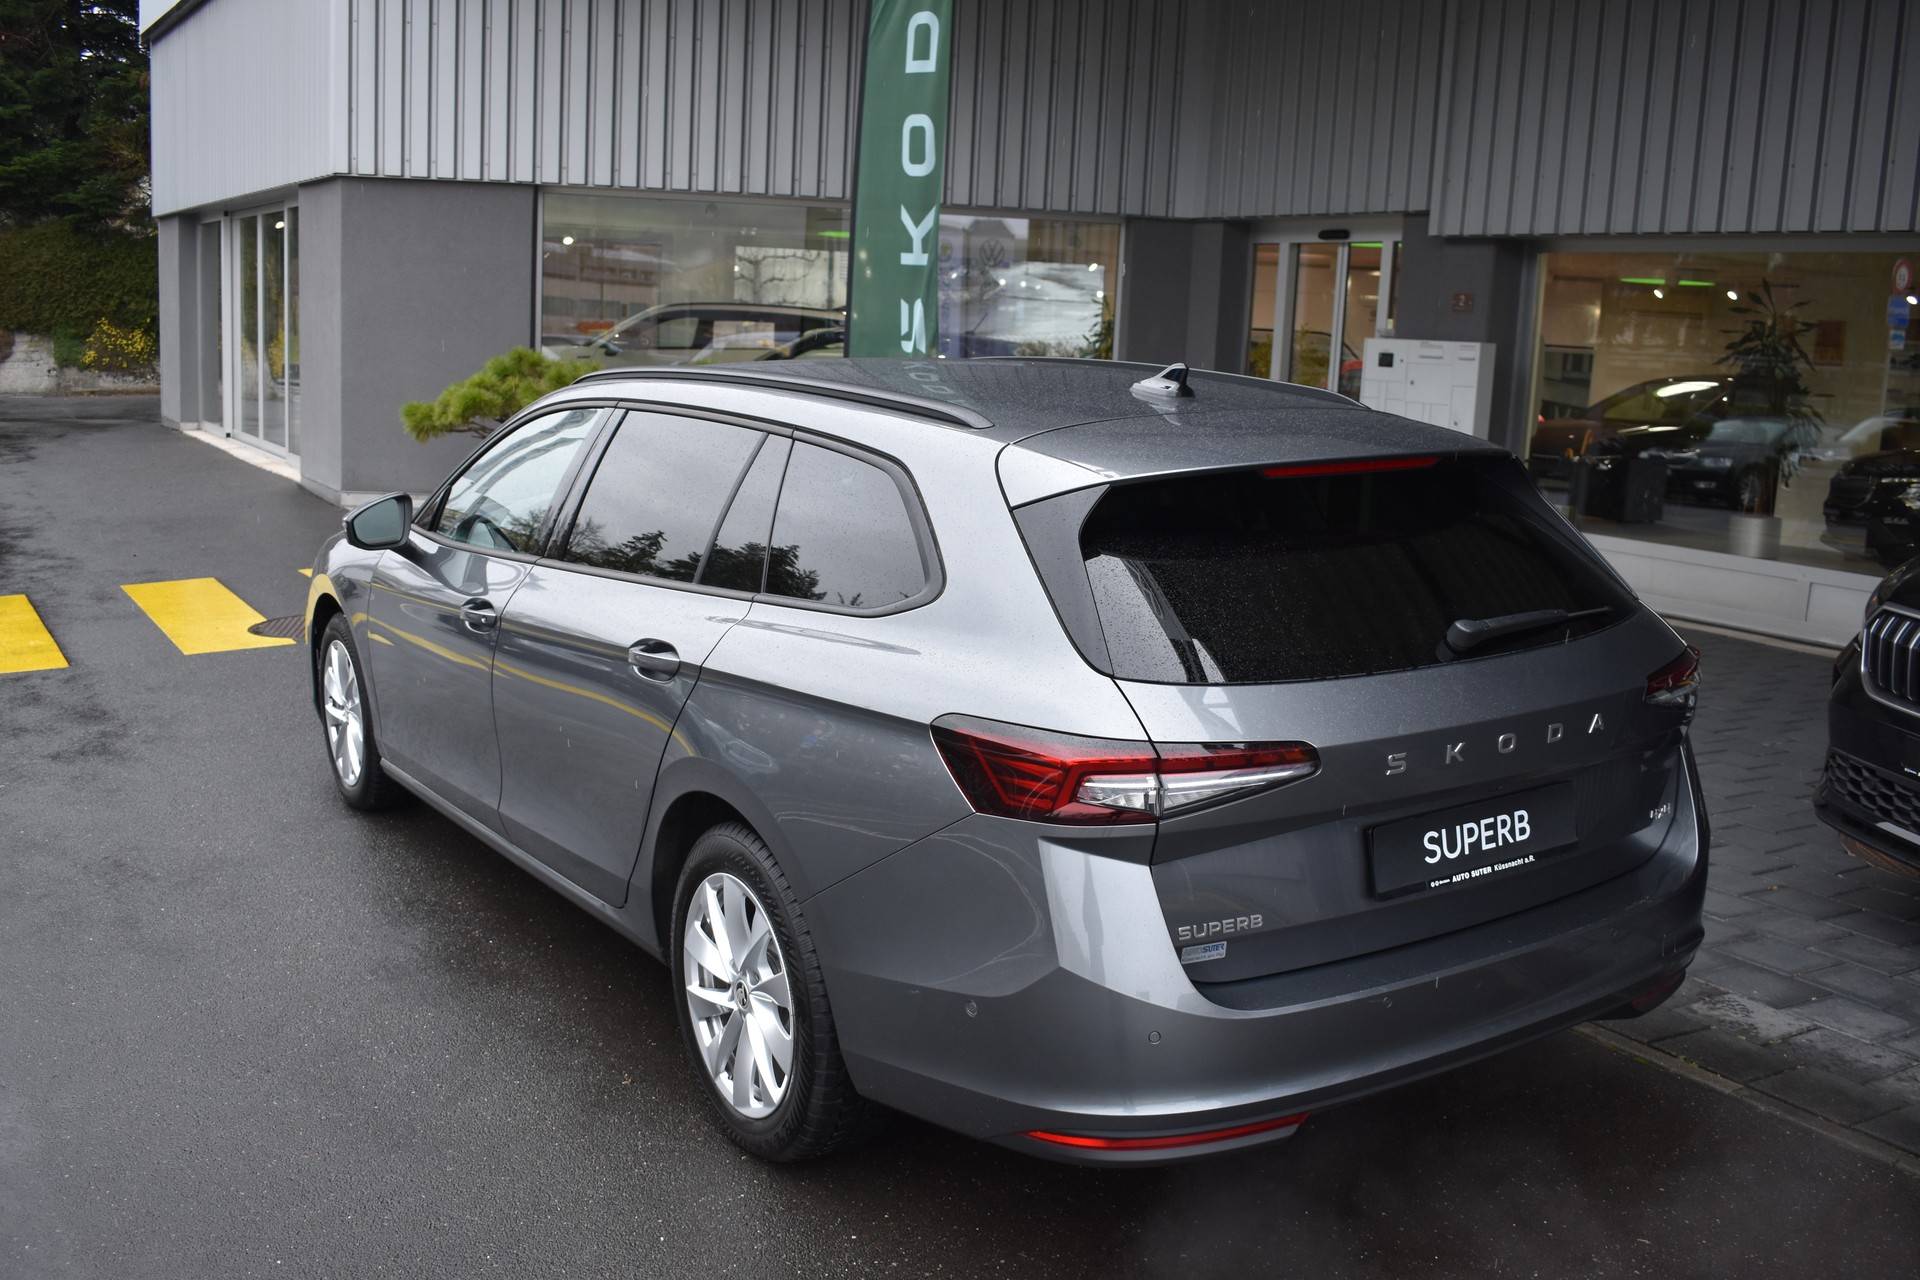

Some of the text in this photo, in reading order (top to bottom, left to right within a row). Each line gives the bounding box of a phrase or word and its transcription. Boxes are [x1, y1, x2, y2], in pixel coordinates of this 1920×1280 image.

[1423, 809, 1531, 864] SUPERB
[1452, 872, 1470, 883] AUTO
[1471, 866, 1493, 878] SUTER
[1494, 857, 1524, 872] Küssnacht
[1178, 914, 1263, 941] SUPERB
